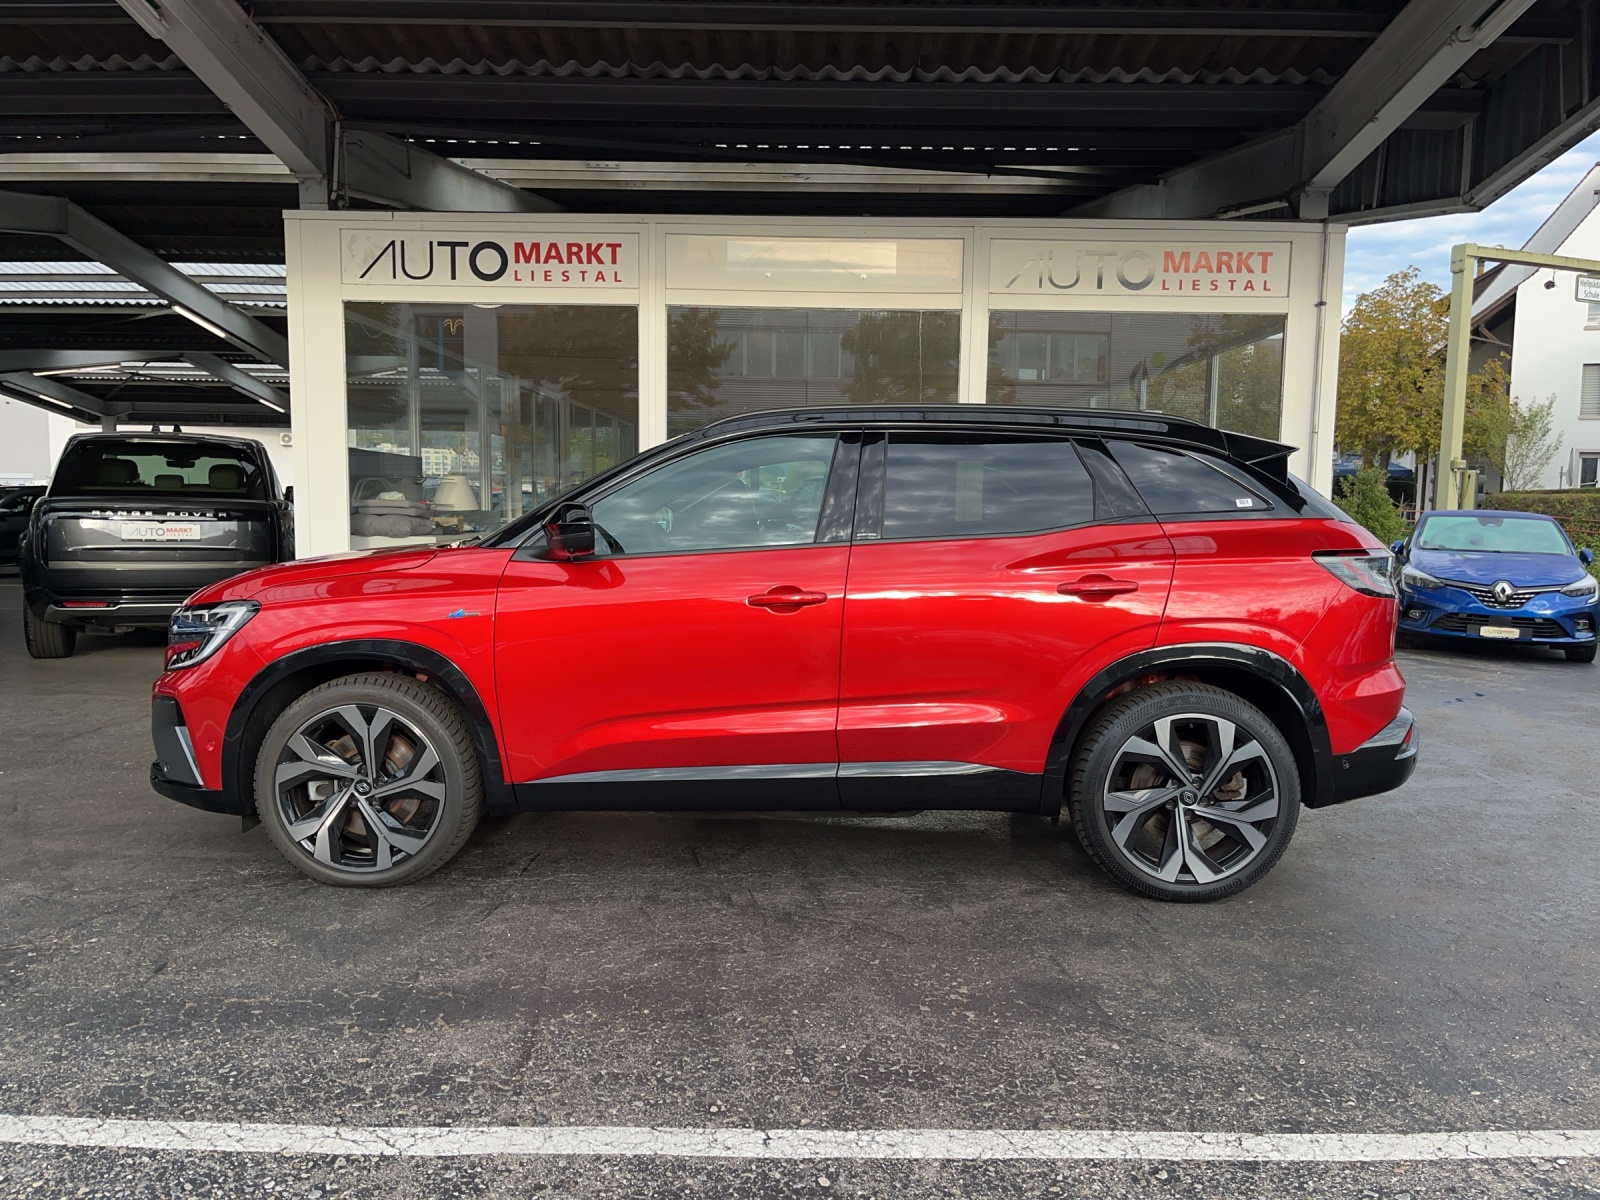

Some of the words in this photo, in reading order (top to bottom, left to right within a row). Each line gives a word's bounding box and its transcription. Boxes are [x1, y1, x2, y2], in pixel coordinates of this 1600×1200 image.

[359, 240, 509, 282] AUTO
[514, 241, 622, 265] MARKT
[514, 269, 622, 283] LIESTAL
[1004, 248, 1156, 291] AUTO
[1162, 250, 1273, 274] MARKT
[1161, 279, 1272, 292] LIESTAL
[91, 509, 153, 517] RANGE
[166, 510, 227, 518] ROVER
[129, 527, 166, 537] AUTO
